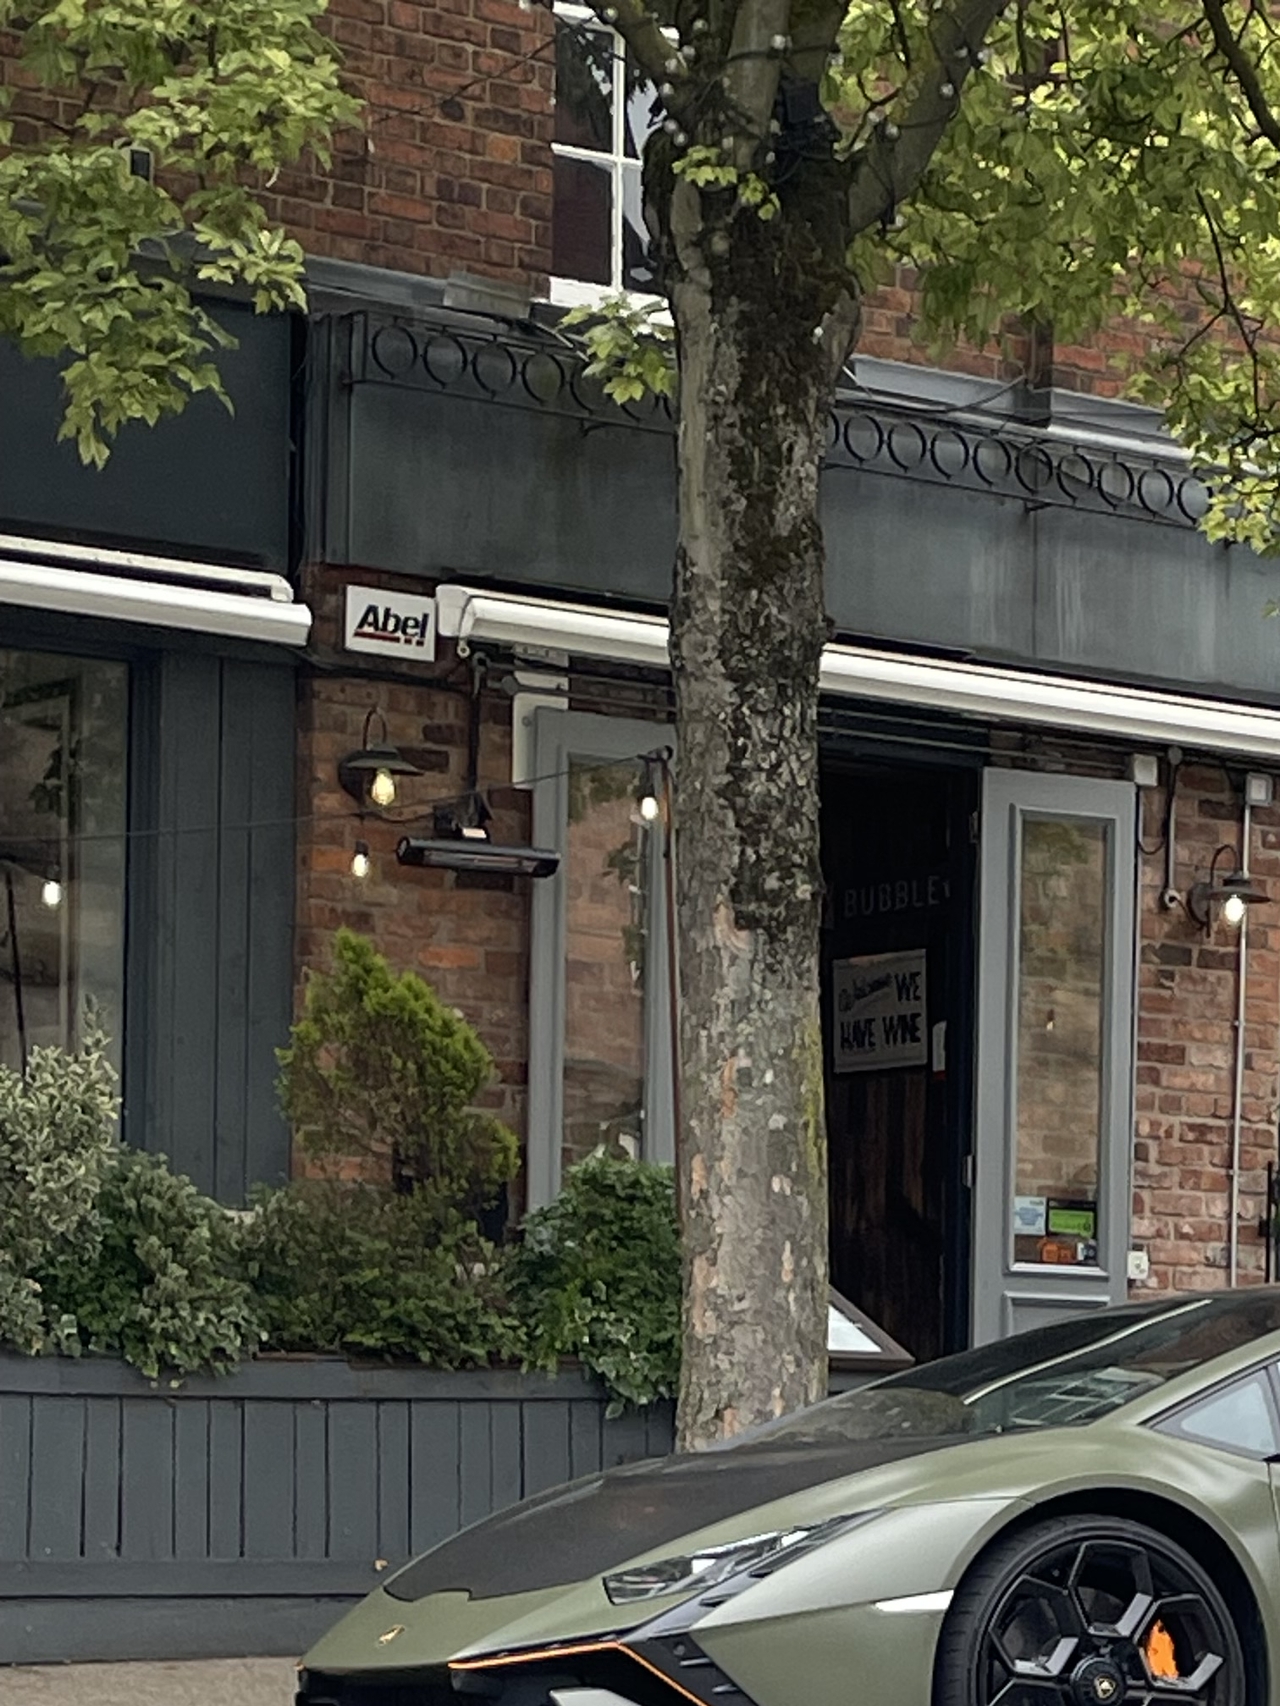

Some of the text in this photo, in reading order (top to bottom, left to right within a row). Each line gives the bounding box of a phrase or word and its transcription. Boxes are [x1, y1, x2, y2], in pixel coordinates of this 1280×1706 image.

[355, 604, 429, 639] Abel
[894, 971, 921, 1002] WE
[840, 1012, 922, 1050] HAVE WINE
